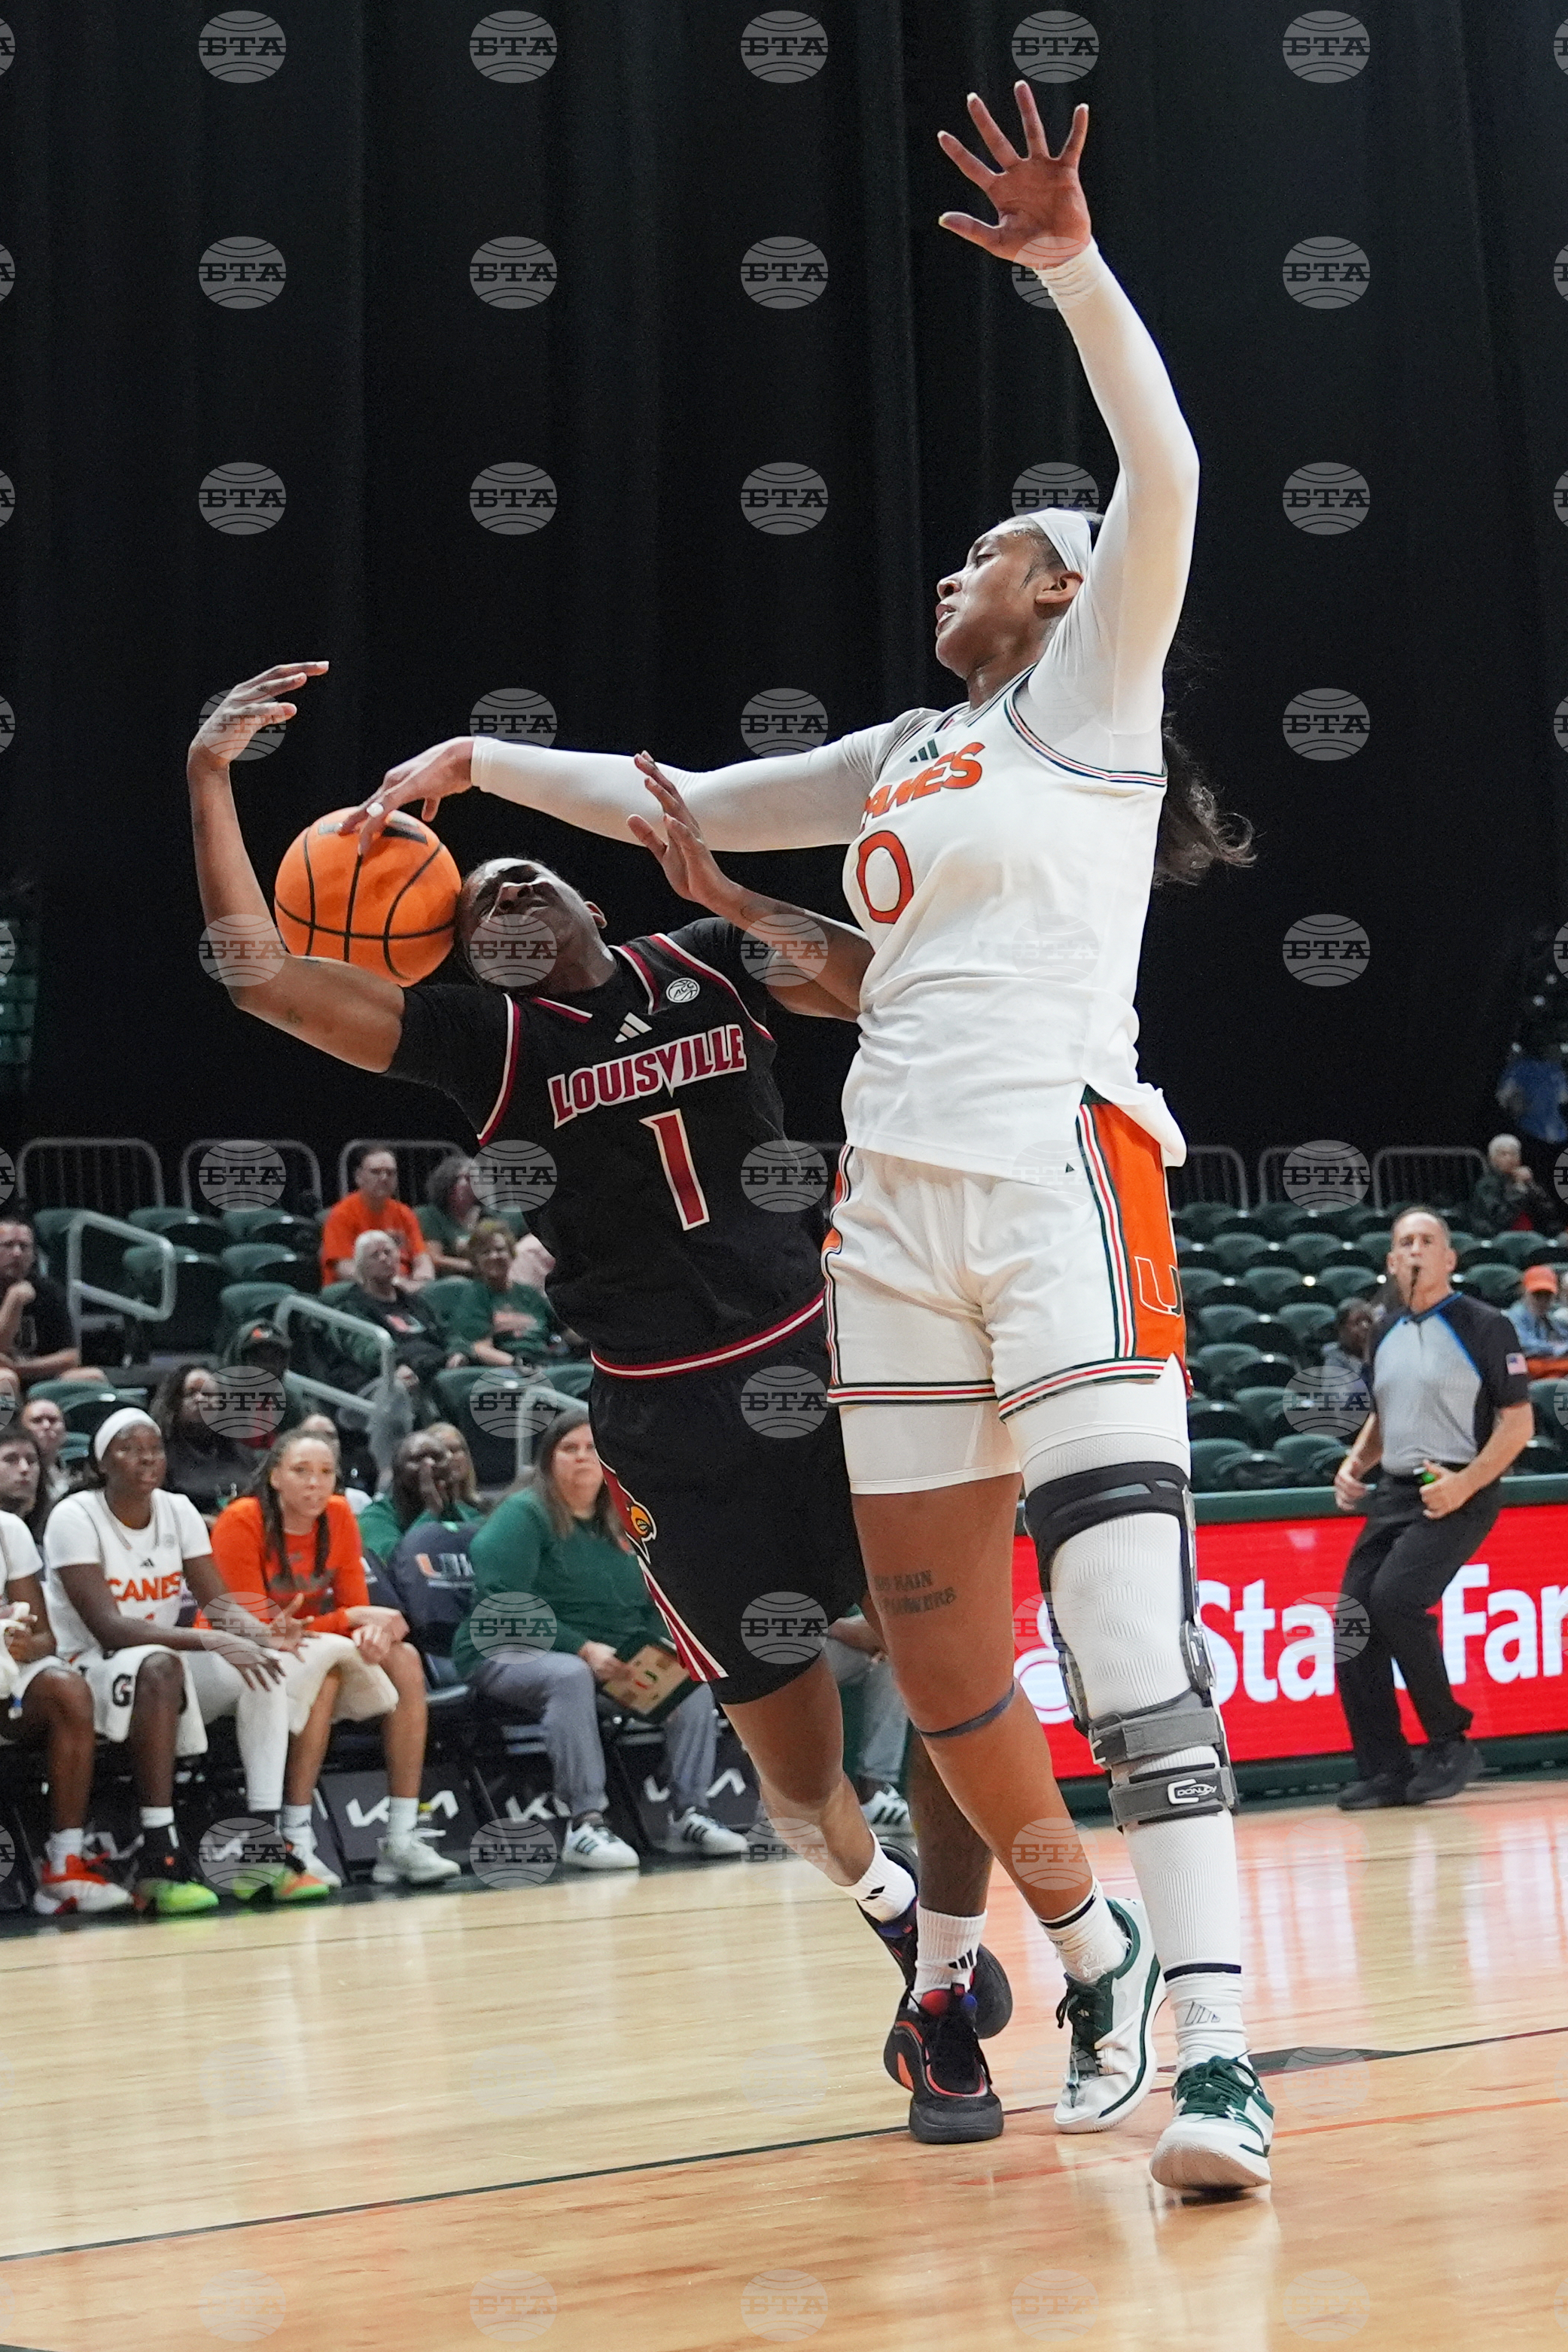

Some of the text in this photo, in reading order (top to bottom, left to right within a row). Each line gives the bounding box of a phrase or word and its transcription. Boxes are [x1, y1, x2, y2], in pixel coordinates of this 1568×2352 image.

[864, 742, 985, 819] ANES
[856, 830, 915, 925] 0
[547, 1024, 747, 1129] LOUISVILLE
[639, 1108, 711, 1231] 1
